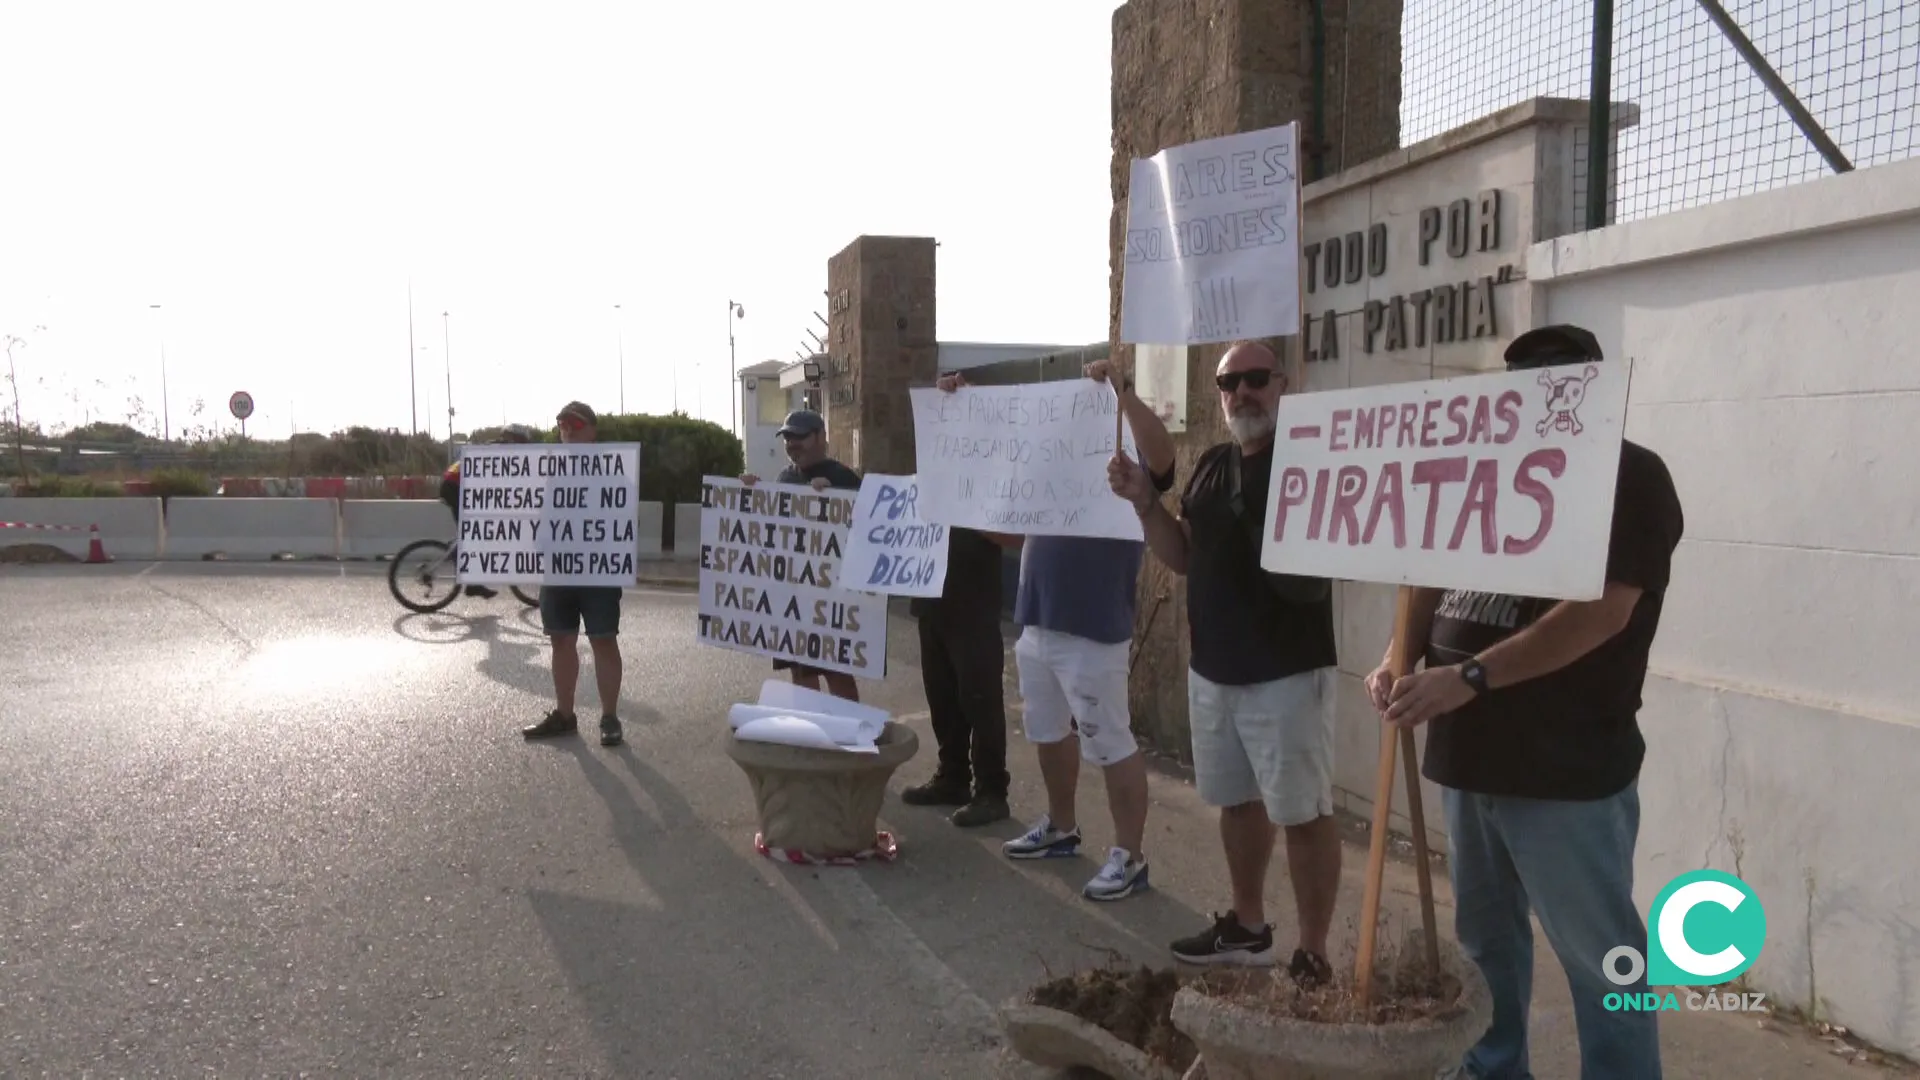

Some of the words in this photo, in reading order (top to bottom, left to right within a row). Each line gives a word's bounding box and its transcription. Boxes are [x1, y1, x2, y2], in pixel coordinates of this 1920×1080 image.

[1303, 222, 1387, 294] TODO
[1418, 188, 1501, 267] POR
[1303, 309, 1338, 363] LA
[968, 392, 1030, 426] PADRES
[1038, 395, 1060, 425] DE
[1329, 389, 1523, 452] EMPRESAS
[463, 455, 530, 478] DEFENSA
[538, 454, 625, 476] CONTRATA
[1040, 438, 1074, 462] SIN
[462, 487, 545, 510] EMPRESAS
[553, 487, 589, 508] QUE
[600, 487, 627, 508] NO
[702, 483, 854, 525] INTERVENCION
[869, 483, 918, 520] POR
[958, 475, 975, 501] UN
[1043, 480, 1056, 501] A
[1273, 447, 1567, 556] PIRATAS
[461, 520, 521, 541] PAGAN
[530, 519, 540, 541] Y
[550, 520, 573, 541] YA
[583, 520, 606, 541] ES
[613, 520, 634, 541] LA
[868, 522, 943, 549] CONTRATO
[479, 553, 509, 574] VEZ
[515, 553, 545, 574] QUE
[552, 553, 584, 574] NOS
[589, 553, 633, 574] PASA
[701, 545, 832, 588] ESPAÑOLAS
[866, 553, 935, 588] DIGNO
[714, 582, 772, 616] PAGA
[783, 595, 801, 621] A
[813, 599, 860, 632] SUS
[698, 613, 868, 668] TRABAJADORES
